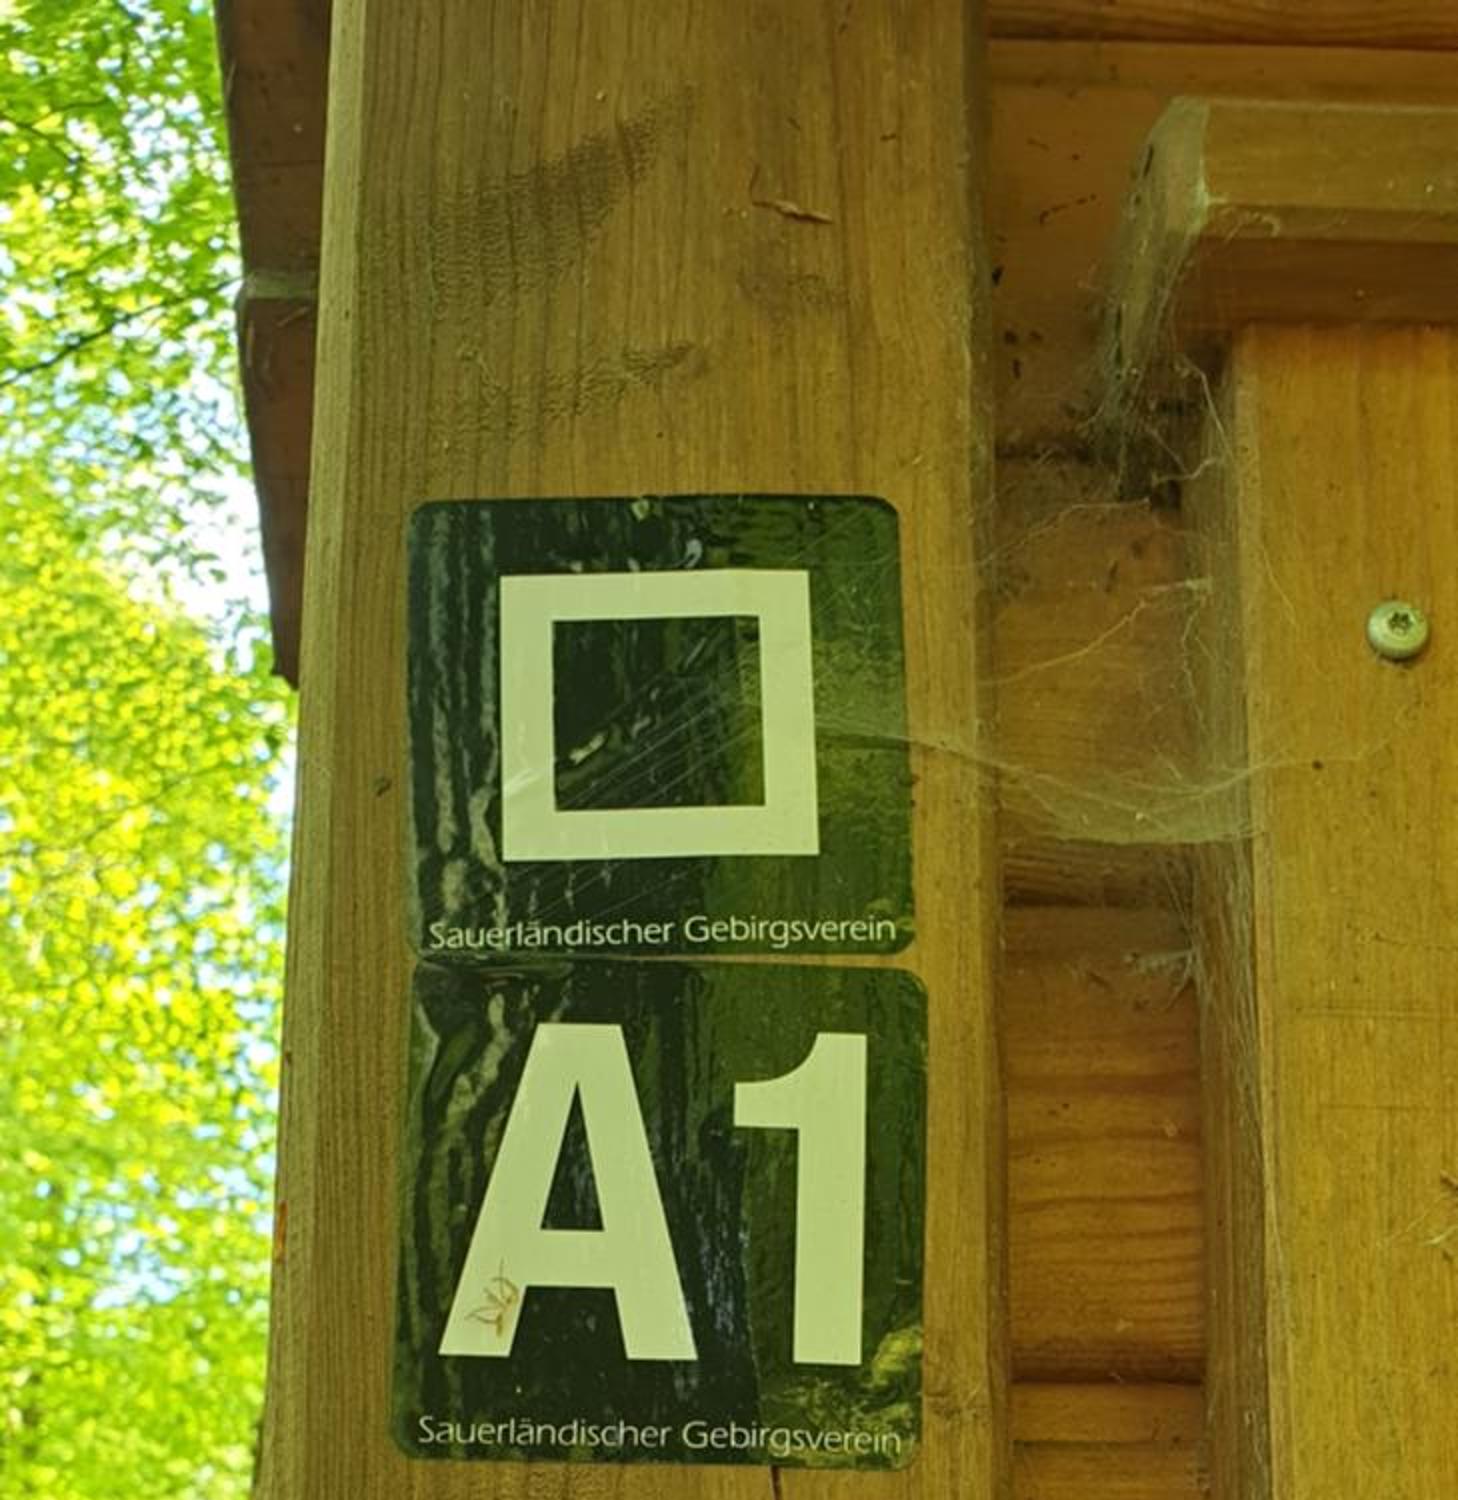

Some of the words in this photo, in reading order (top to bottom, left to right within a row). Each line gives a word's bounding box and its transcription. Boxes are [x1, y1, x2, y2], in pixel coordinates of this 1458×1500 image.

[429, 919, 671, 950] Sauerländischer
[684, 915, 897, 948] Gebirgsverein
[438, 1022, 868, 1365] A1
[417, 1415, 670, 1447] Sauerländischer
[682, 1420, 901, 1457] Gebirgsverein
